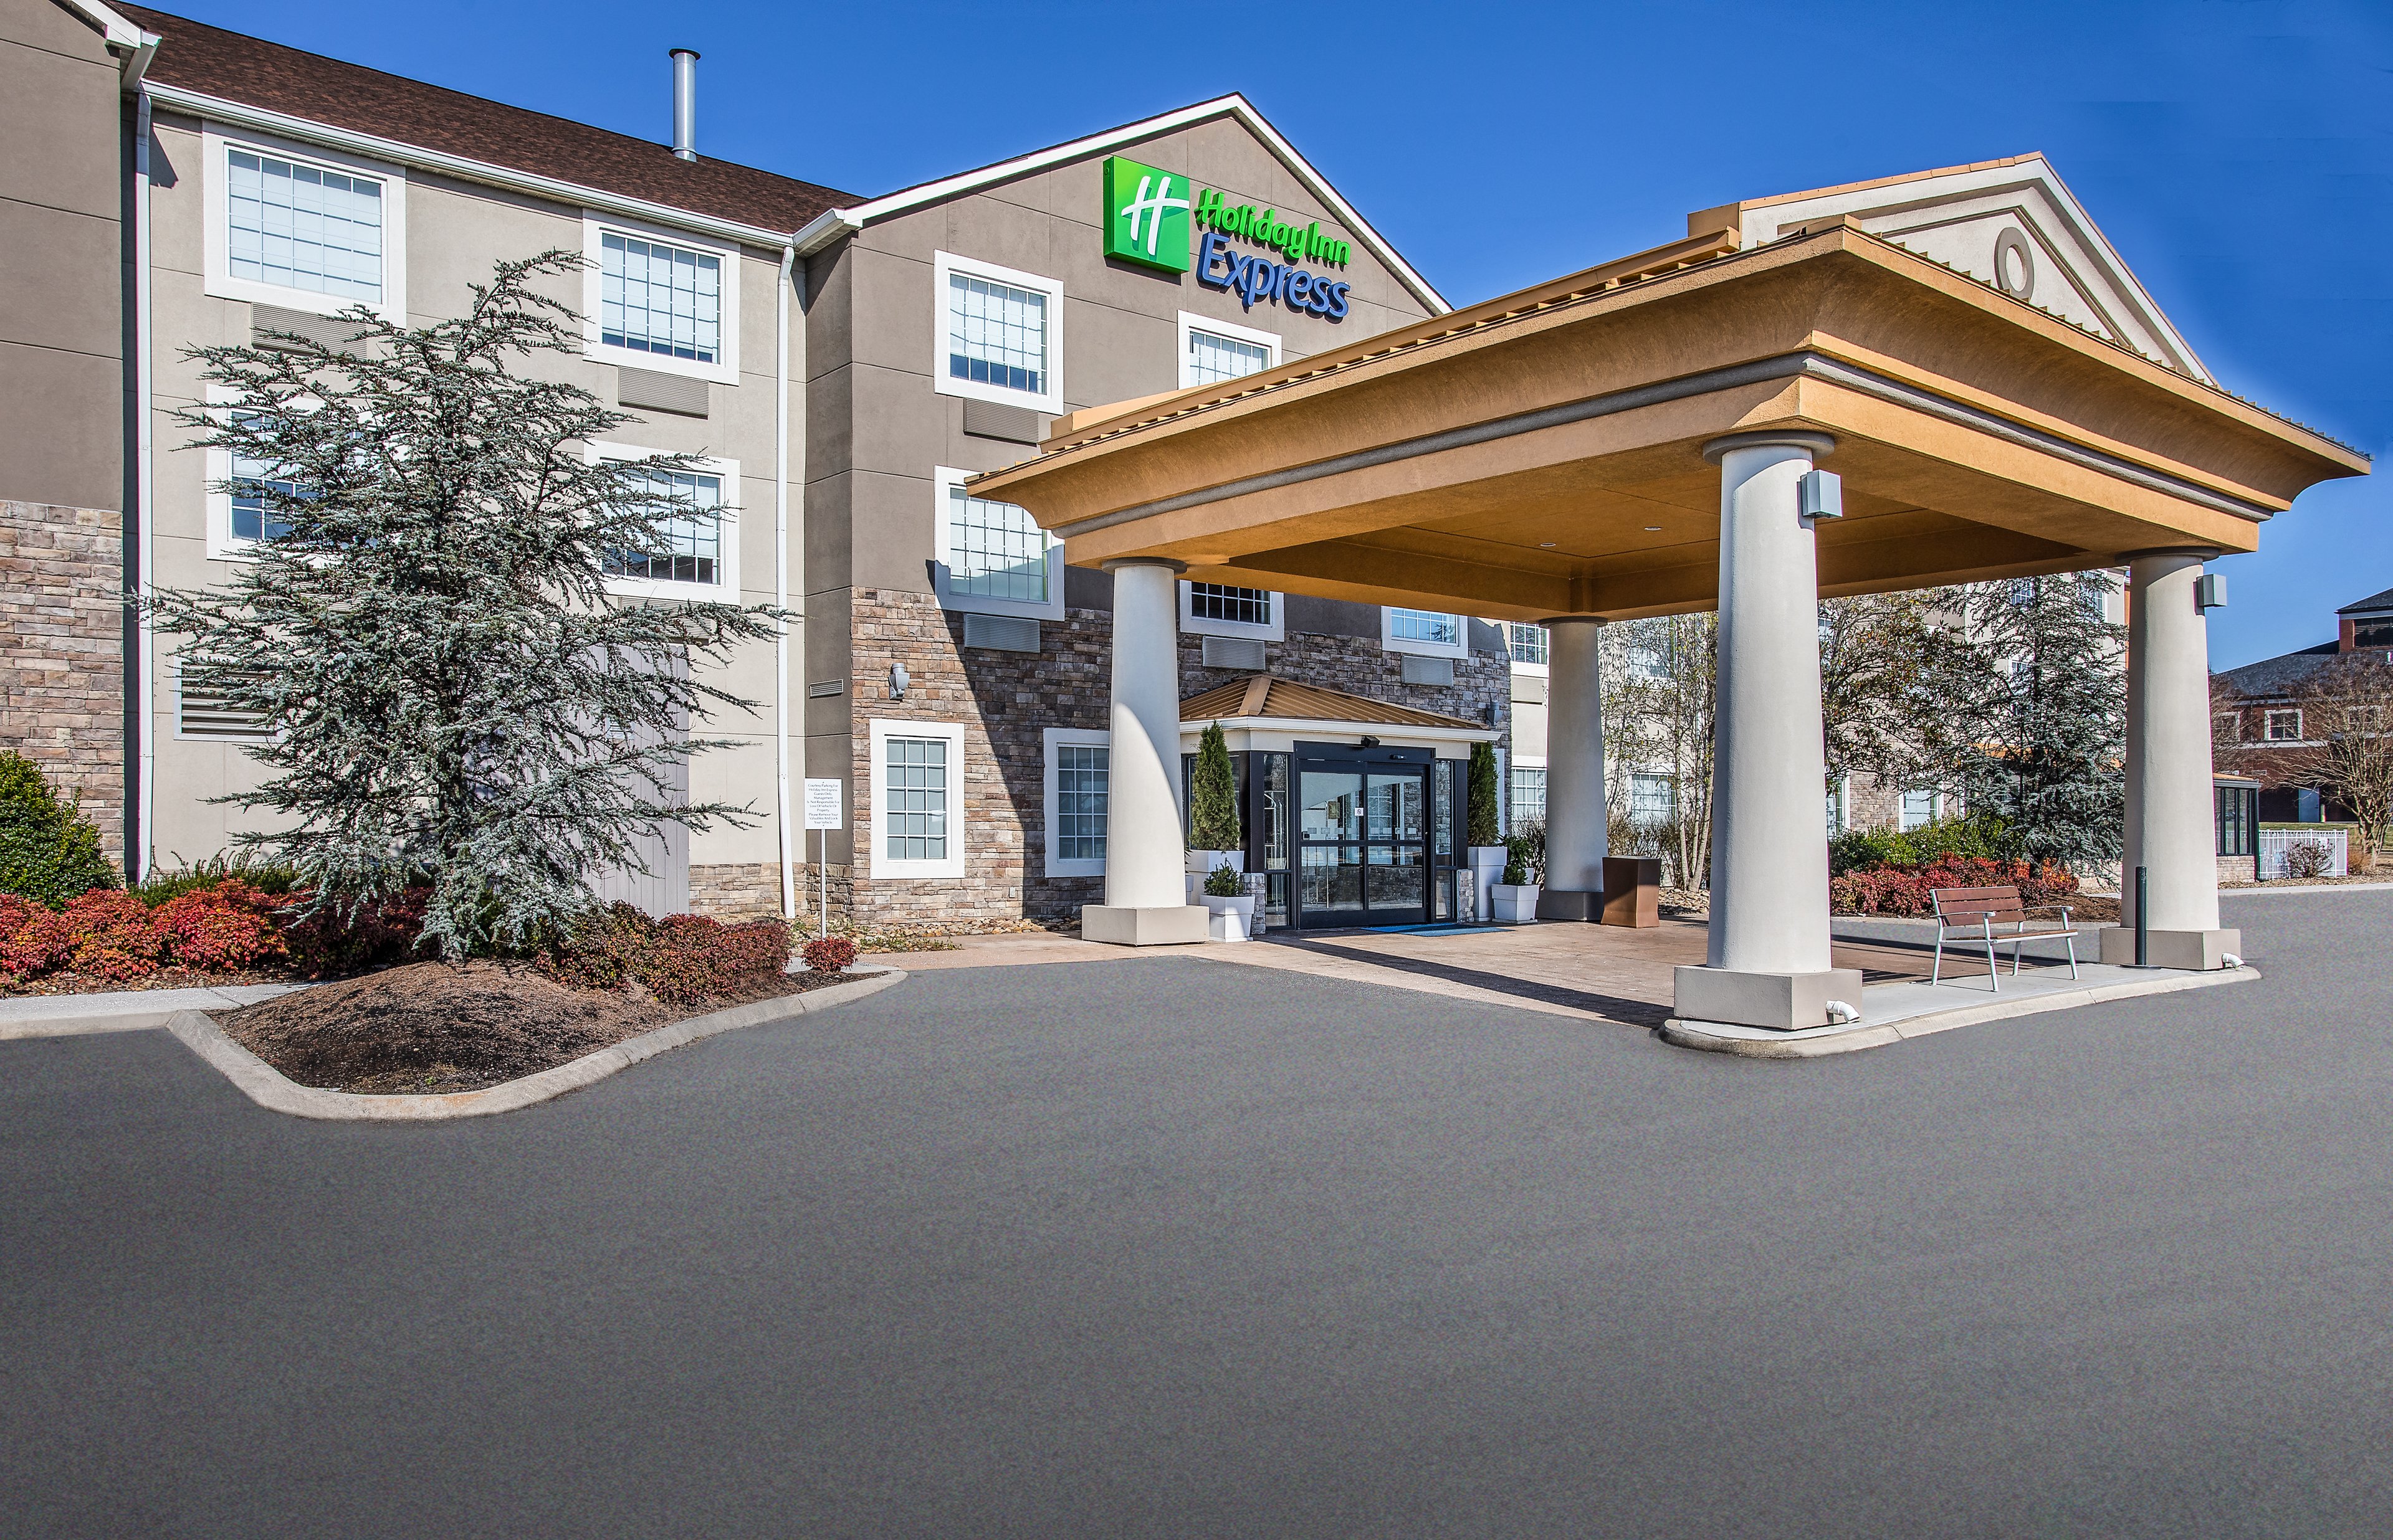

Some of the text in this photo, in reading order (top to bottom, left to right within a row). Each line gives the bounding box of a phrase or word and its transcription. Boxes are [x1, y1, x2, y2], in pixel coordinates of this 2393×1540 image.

[1195, 188, 1351, 265] Holiday Inn
[1196, 232, 1351, 317] Express
